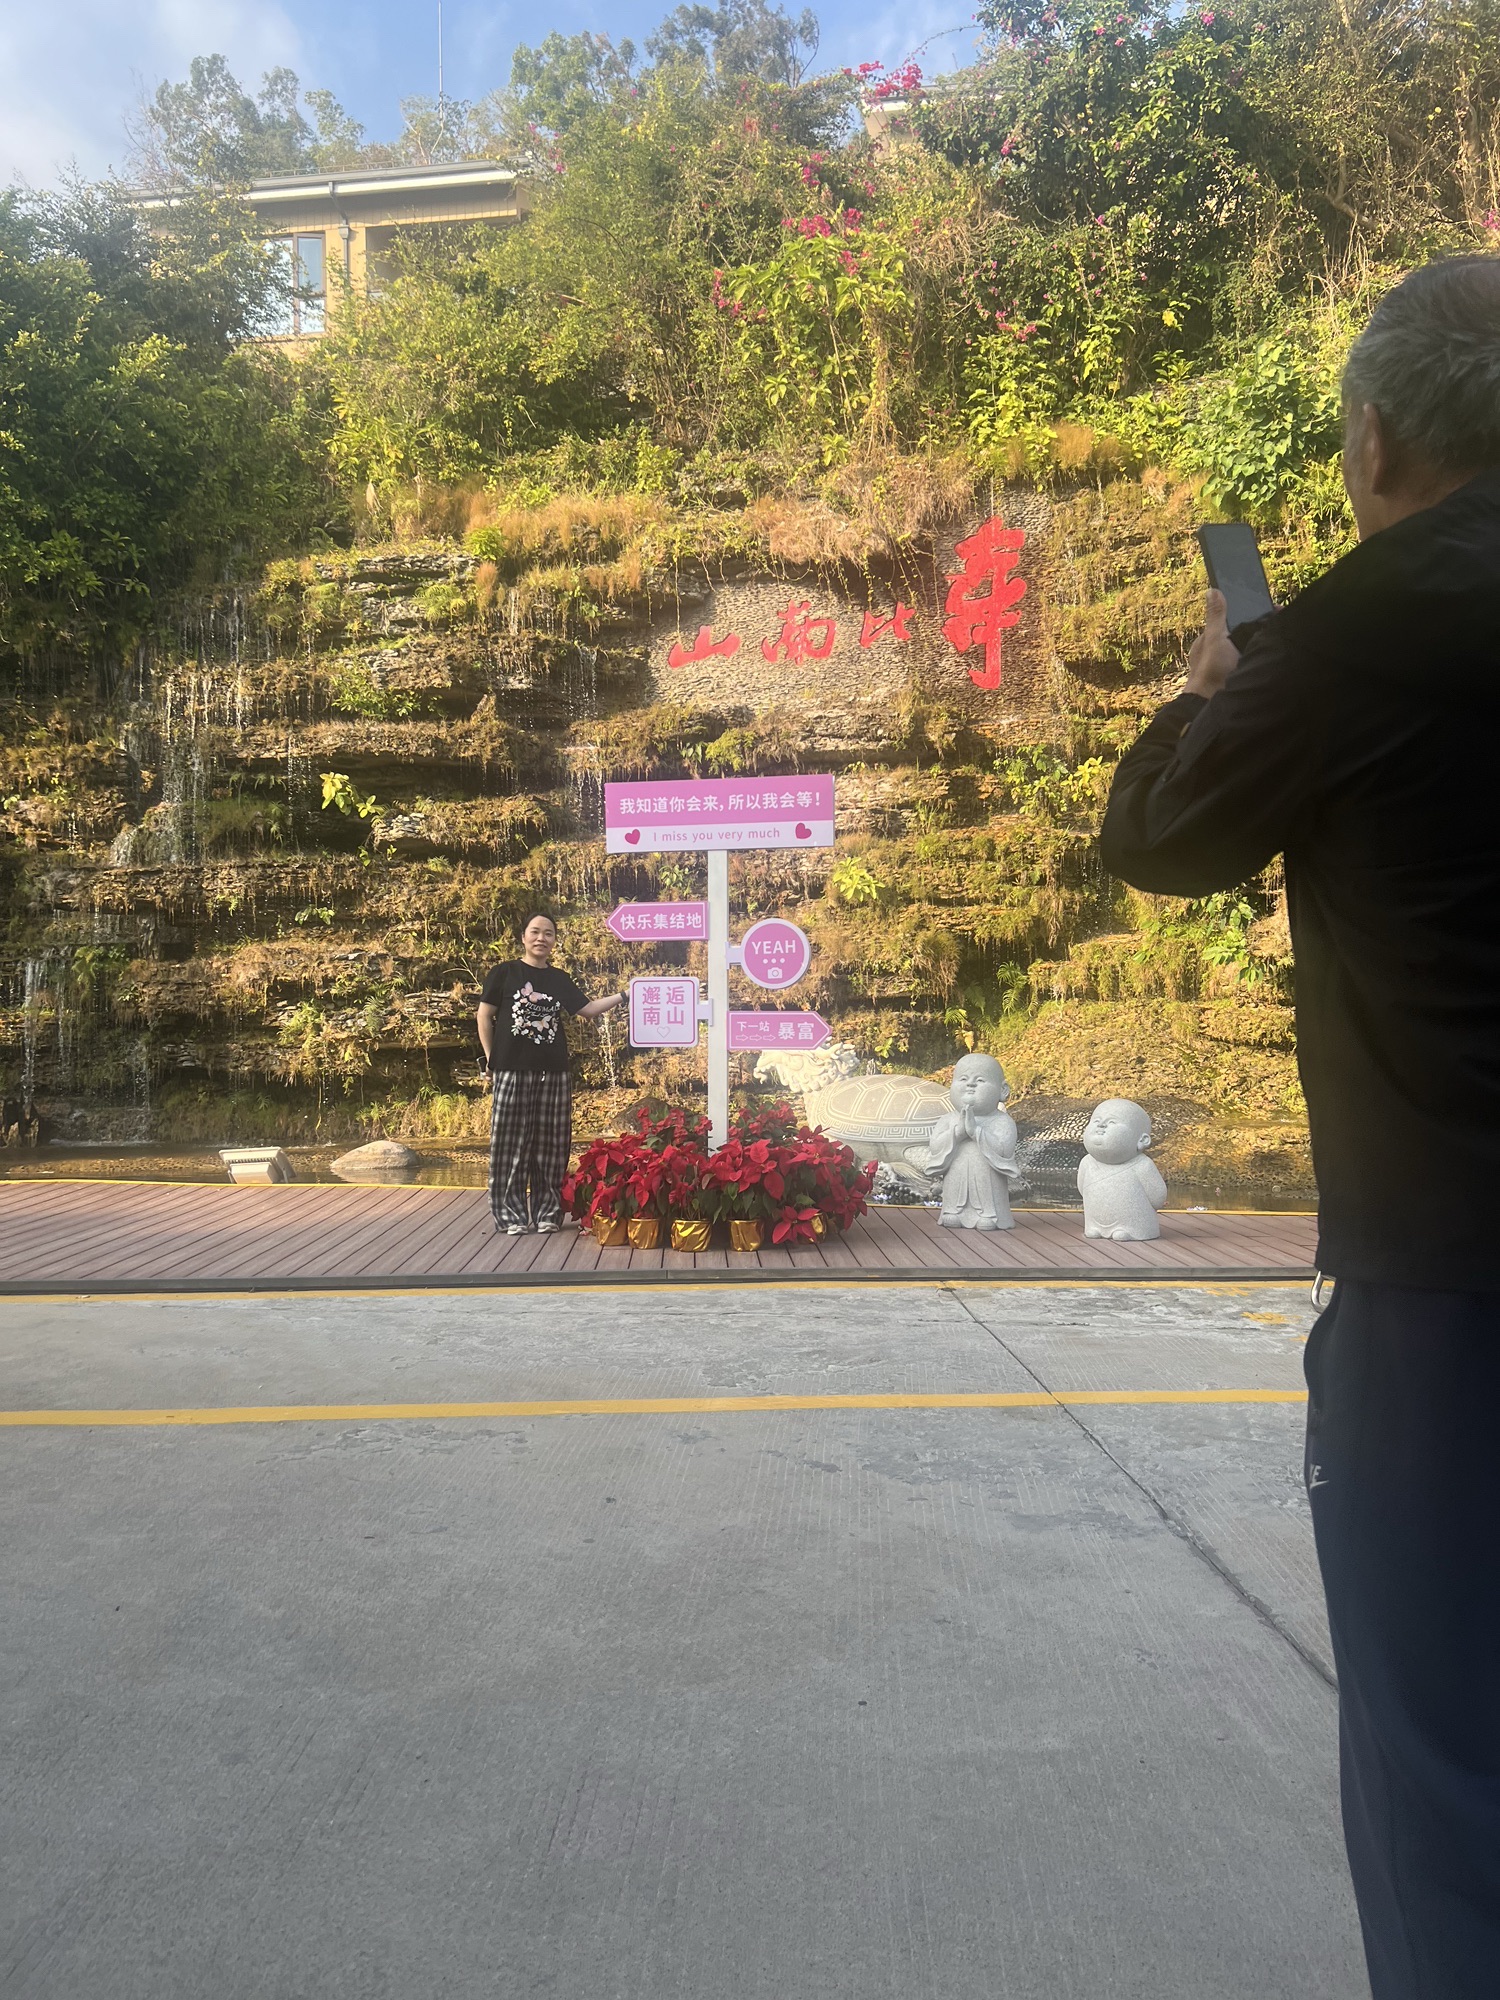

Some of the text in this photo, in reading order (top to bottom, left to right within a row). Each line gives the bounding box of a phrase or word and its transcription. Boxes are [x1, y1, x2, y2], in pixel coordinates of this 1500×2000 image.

[653, 827, 780, 844] I miss you very much
[620, 912, 702, 931] 快乐集结地
[751, 940, 797, 955] YEAH
[642, 986, 685, 1005] 邂逅
[642, 1006, 685, 1026] 南山
[736, 1020, 815, 1040] 下一站 暴富
